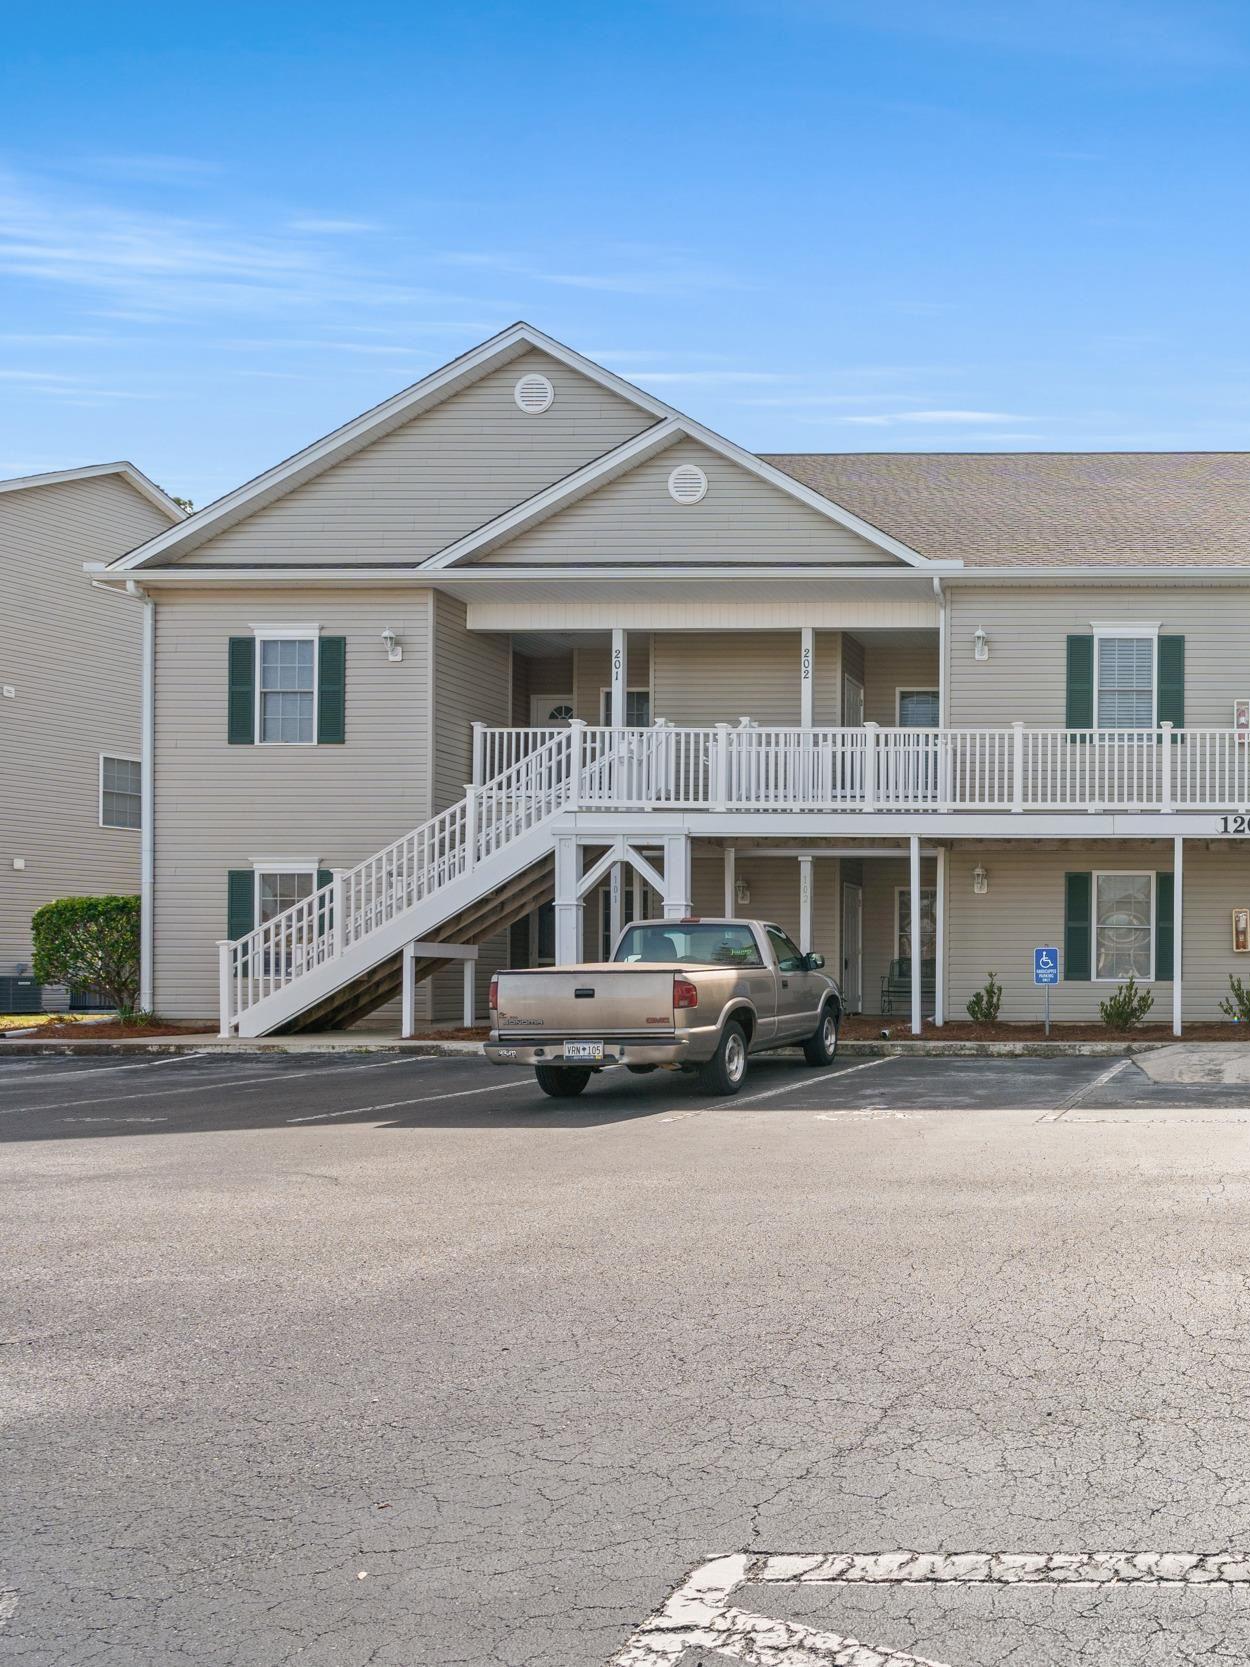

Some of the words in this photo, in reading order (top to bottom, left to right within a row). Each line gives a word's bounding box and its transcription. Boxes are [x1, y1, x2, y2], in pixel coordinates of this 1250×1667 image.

[613, 648, 621, 681] 201
[802, 648, 810, 679] 202
[567, 1045, 581, 1055] VRN
[588, 1045, 601, 1055] 105
